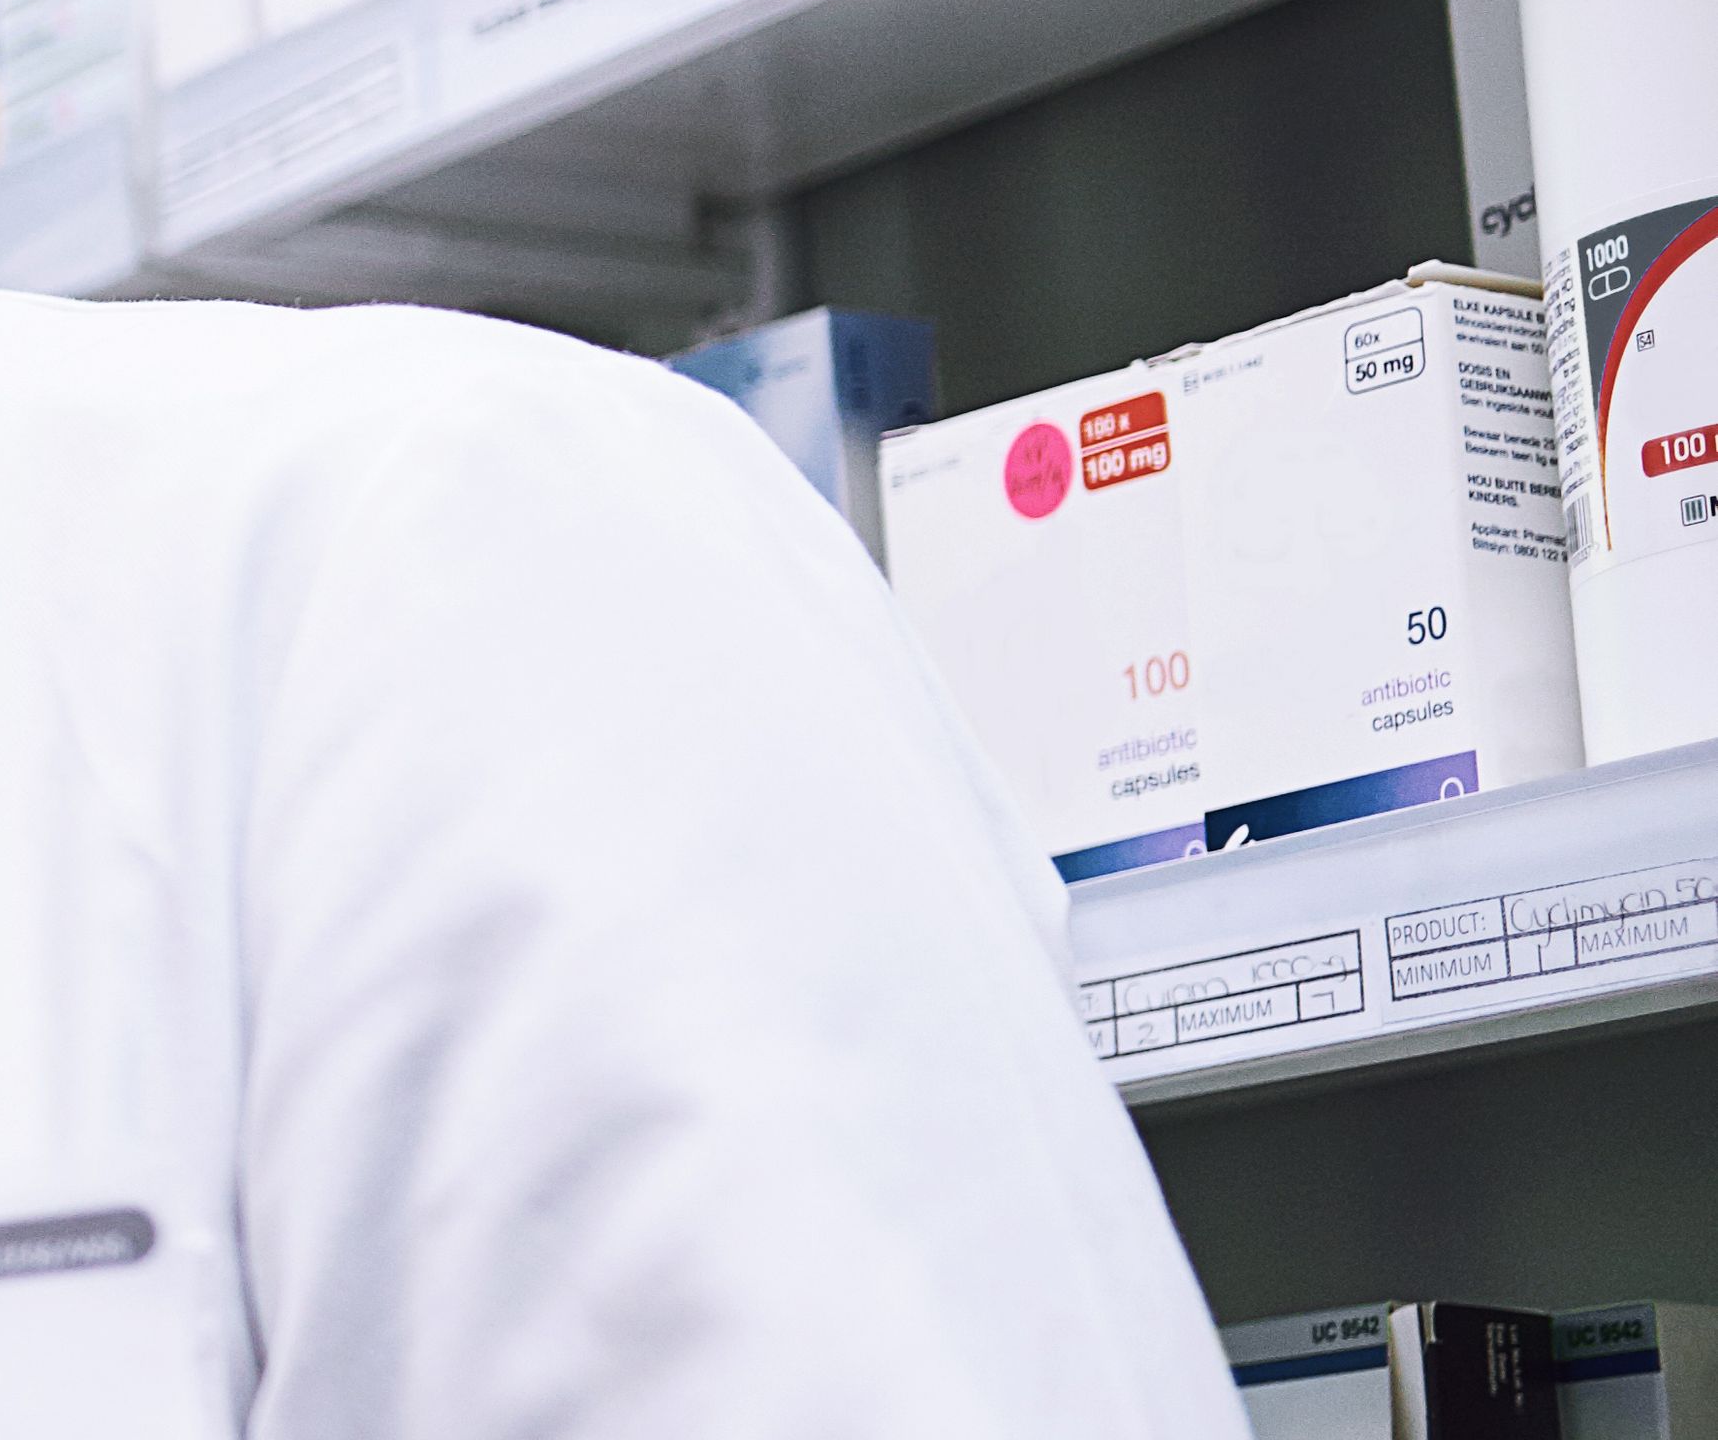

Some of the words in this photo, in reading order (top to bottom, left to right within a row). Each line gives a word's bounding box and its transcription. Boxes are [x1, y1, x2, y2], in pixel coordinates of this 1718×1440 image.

[1586, 235, 1629, 271] 1000
[1453, 298, 1479, 312] ELKE
[1484, 304, 1532, 321] KAPSULE
[1354, 332, 1380, 350] 60x
[1356, 361, 1377, 382] 50
[1382, 354, 1414, 374] mg
[1458, 361, 1493, 377] DOSIS
[1495, 367, 1511, 380] EN
[1460, 378, 1553, 402] GEBRUIKSAANW
[1084, 412, 1114, 440] 100
[1086, 452, 1124, 482] 100
[1130, 442, 1167, 470] mg
[1660, 431, 1706, 465] 100
[1467, 473, 1492, 487] HOU
[1495, 477, 1526, 494] BUITE
[1407, 606, 1447, 646] 50
[1122, 650, 1190, 701] 100
[1361, 668, 1452, 707] antibiotic
[1372, 698, 1454, 733] capsules
[1097, 726, 1198, 769] antibiotic
[1111, 760, 1201, 801] capsules
[1393, 911, 1486, 946] PRODUCT:
[1580, 916, 1689, 954] MAXIMUM
[1396, 953, 1492, 988] MINIMUM
[1181, 998, 1273, 1033] MAXIMUM
[1311, 1323, 1336, 1343] UC
[1340, 1316, 1380, 1340] 9542
[1568, 1325, 1596, 1346] UC
[1601, 1319, 1643, 1343] 9542
